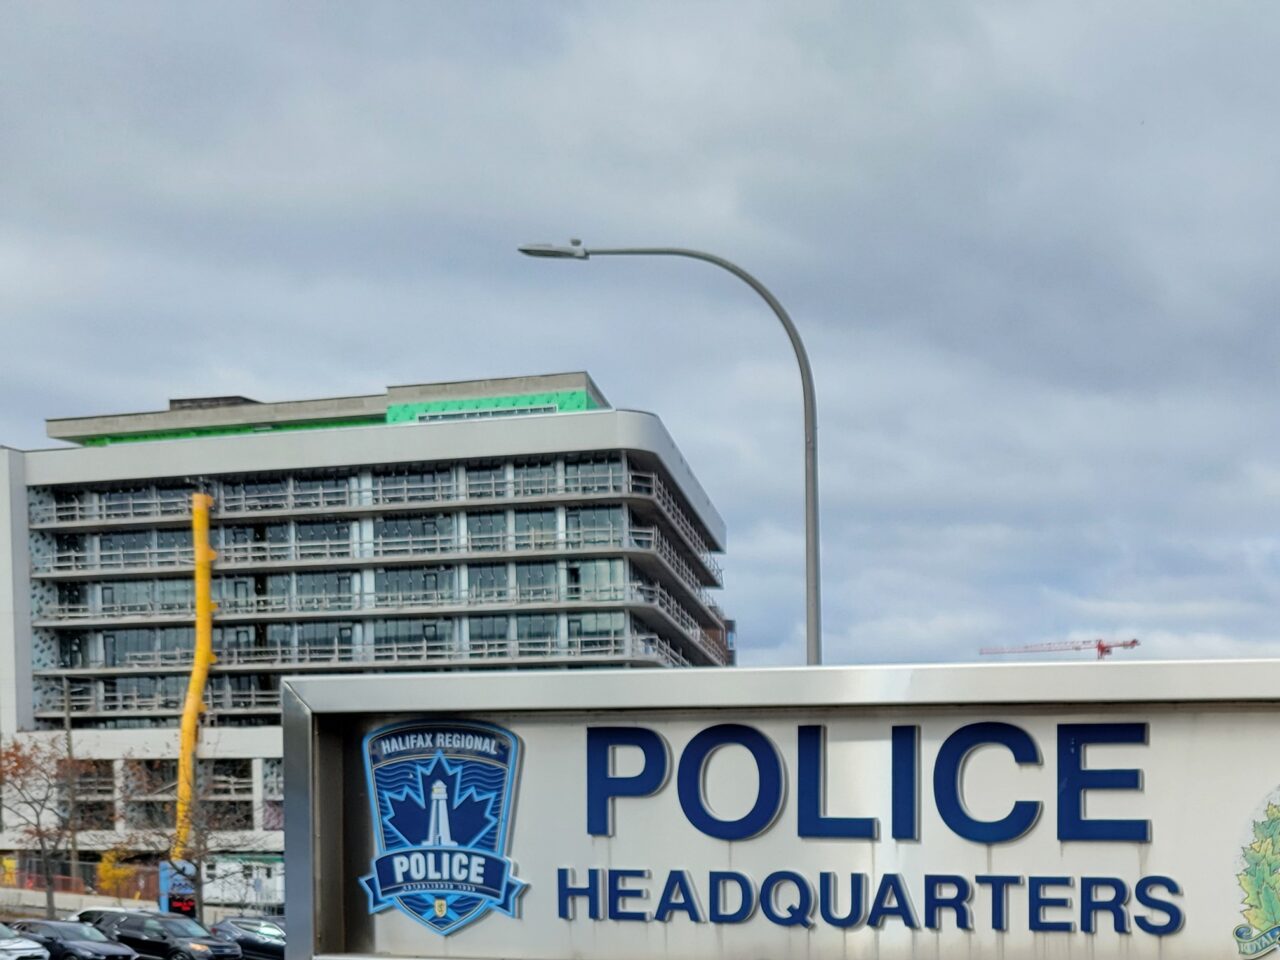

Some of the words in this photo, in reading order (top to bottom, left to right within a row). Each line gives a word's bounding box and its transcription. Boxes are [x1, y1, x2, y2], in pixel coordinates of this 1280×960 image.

[381, 733, 433, 755] HALIFAX
[436, 733, 498, 755] REGIONAL
[586, 721, 1151, 844] POLICE
[393, 853, 486, 884] POLICE
[557, 867, 1185, 936] HEADQUARTERS
